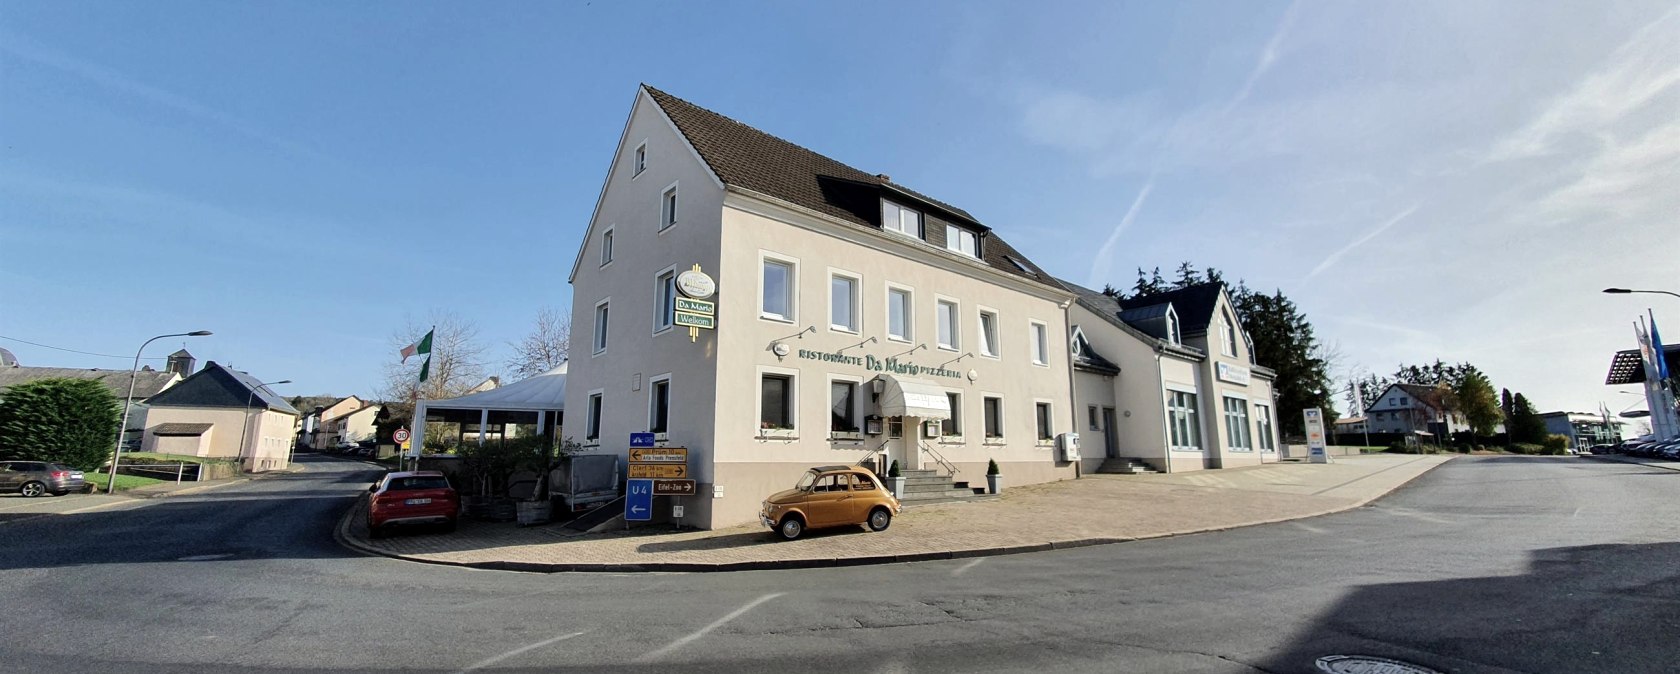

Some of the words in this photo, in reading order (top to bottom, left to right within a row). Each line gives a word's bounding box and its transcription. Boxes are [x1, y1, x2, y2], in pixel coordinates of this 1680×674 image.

[679, 300, 689, 308] Da
[691, 302, 712, 312] Mario
[680, 314, 709, 325] Welkom
[799, 349, 863, 366] RISTORANTE
[865, 354, 882, 371] Da
[885, 357, 919, 376] Mario
[920, 366, 961, 379] PIZZERIA
[632, 486, 639, 495] U
[641, 486, 647, 494] 4
[658, 483, 682, 491] Eifel-Zoo
